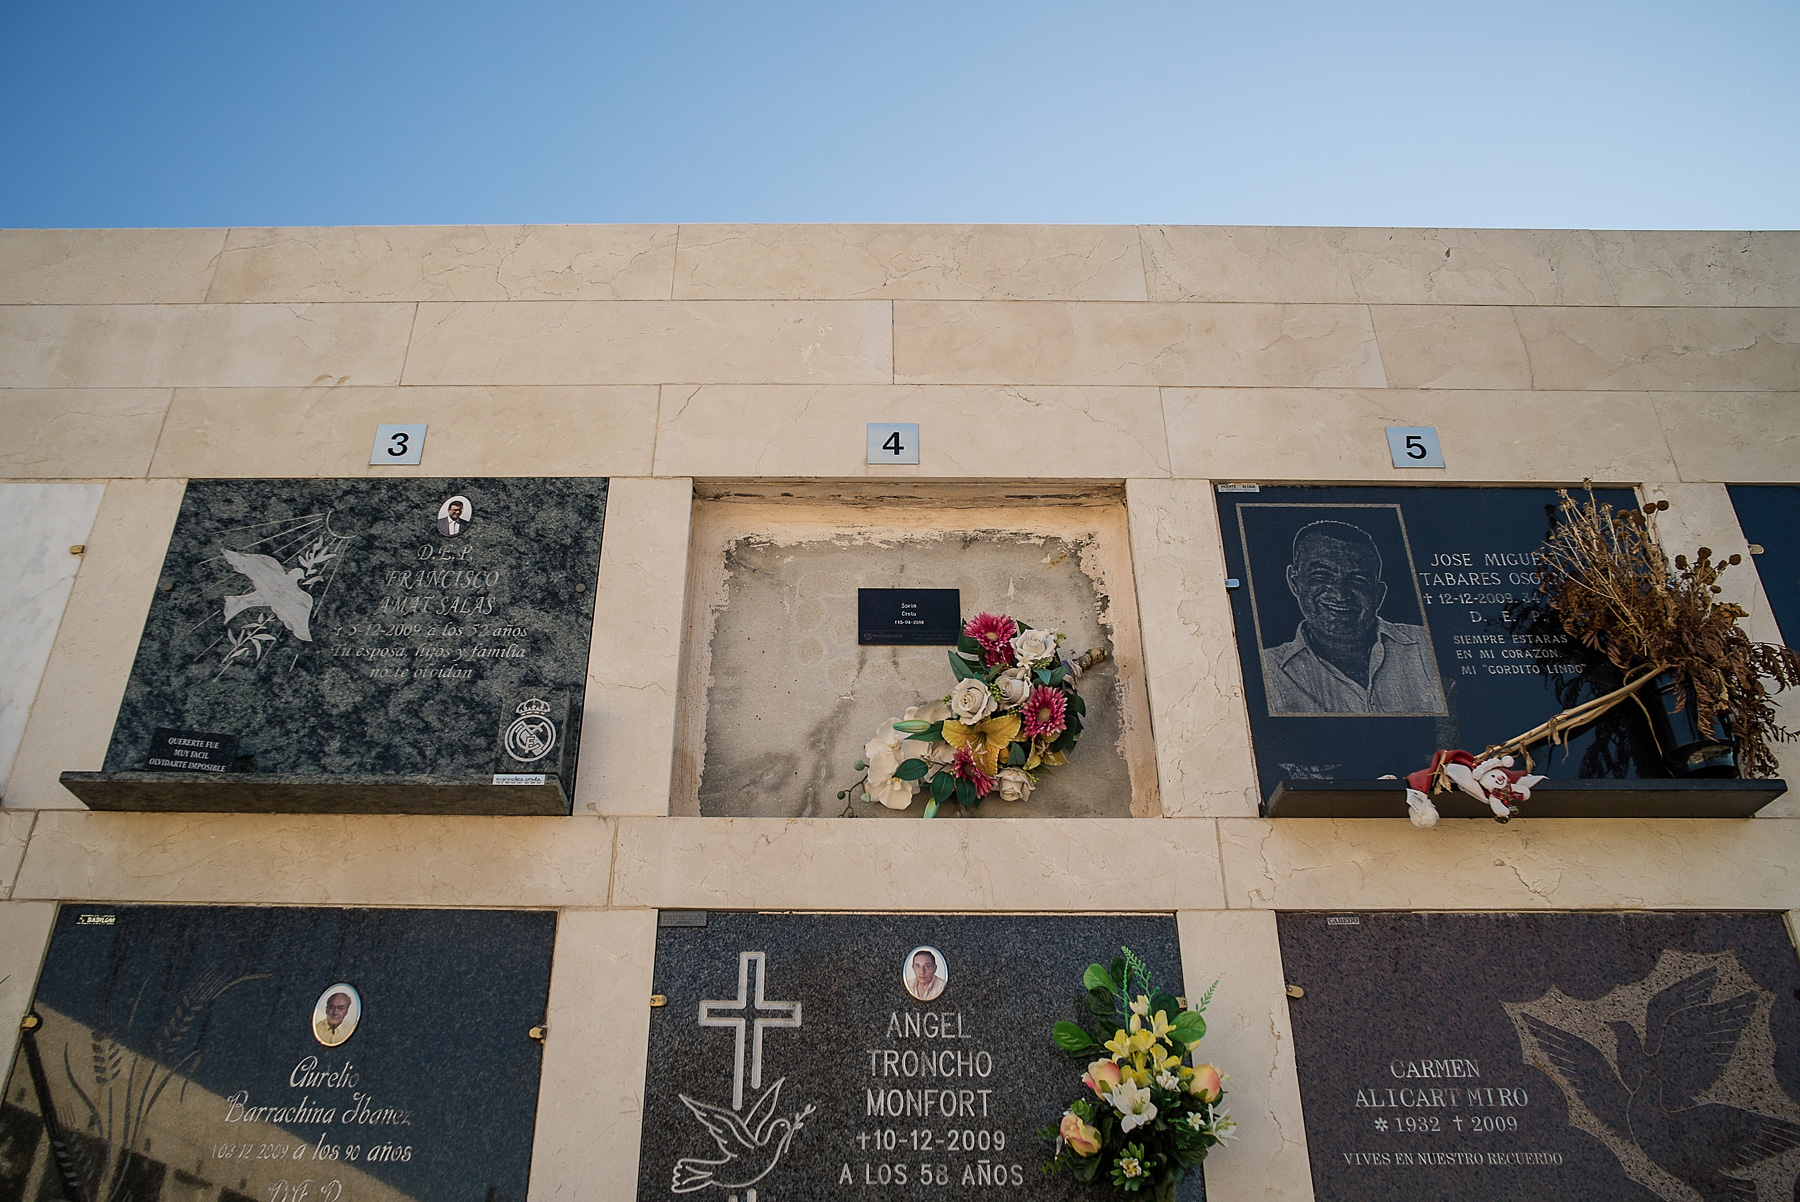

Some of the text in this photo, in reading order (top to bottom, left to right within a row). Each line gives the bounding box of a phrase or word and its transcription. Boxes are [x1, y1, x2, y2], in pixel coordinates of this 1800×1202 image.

[387, 432, 410, 457] 3
[882, 431, 905, 456] 4
[1405, 435, 1427, 460] 5
[1430, 553, 1473, 567] JOSE
[385, 570, 500, 590] FRANCISCO
[1419, 572, 1501, 586] TABARES
[374, 595, 496, 616] AMAT SALAS
[1522, 592, 1541, 604] 34
[427, 626, 436, 636] a
[442, 622, 464, 637] los
[492, 624, 529, 637] años
[1453, 634, 1568, 645] SIEMPRE ESTARAS
[356, 647, 409, 661] esposa,
[414, 643, 450, 661] hijos
[453, 648, 465, 661] y
[463, 643, 526, 661] familia
[1456, 649, 1473, 659] EN
[1480, 649, 1495, 659] MI
[369, 663, 473, 679] no te olvidan
[1461, 665, 1477, 675] MI
[168, 737, 220, 749] QUERERTE FUE
[173, 749, 209, 760] MUY FACIL
[149, 757, 227, 773] OLVIDARTE IMPOSIBLE
[886, 1012, 972, 1039] ANGEL
[289, 1055, 360, 1088] Aurelio
[866, 1050, 993, 1077] TRONCHO
[1390, 1059, 1481, 1078] CARMEN
[866, 1089, 993, 1117] MONFORT
[1355, 1087, 1529, 1108] ALICART MIRO
[224, 1090, 338, 1124] Barrachina
[1395, 1116, 1518, 1132] 1932 2009
[292, 1143, 308, 1161] a
[312, 1132, 340, 1161] los
[344, 1144, 361, 1161] 90
[367, 1141, 413, 1163] años
[1343, 1152, 1563, 1166] VIVES EN NUESTRO RECUERDO
[839, 1159, 1024, 1186] A LOS 58 AÑOS
